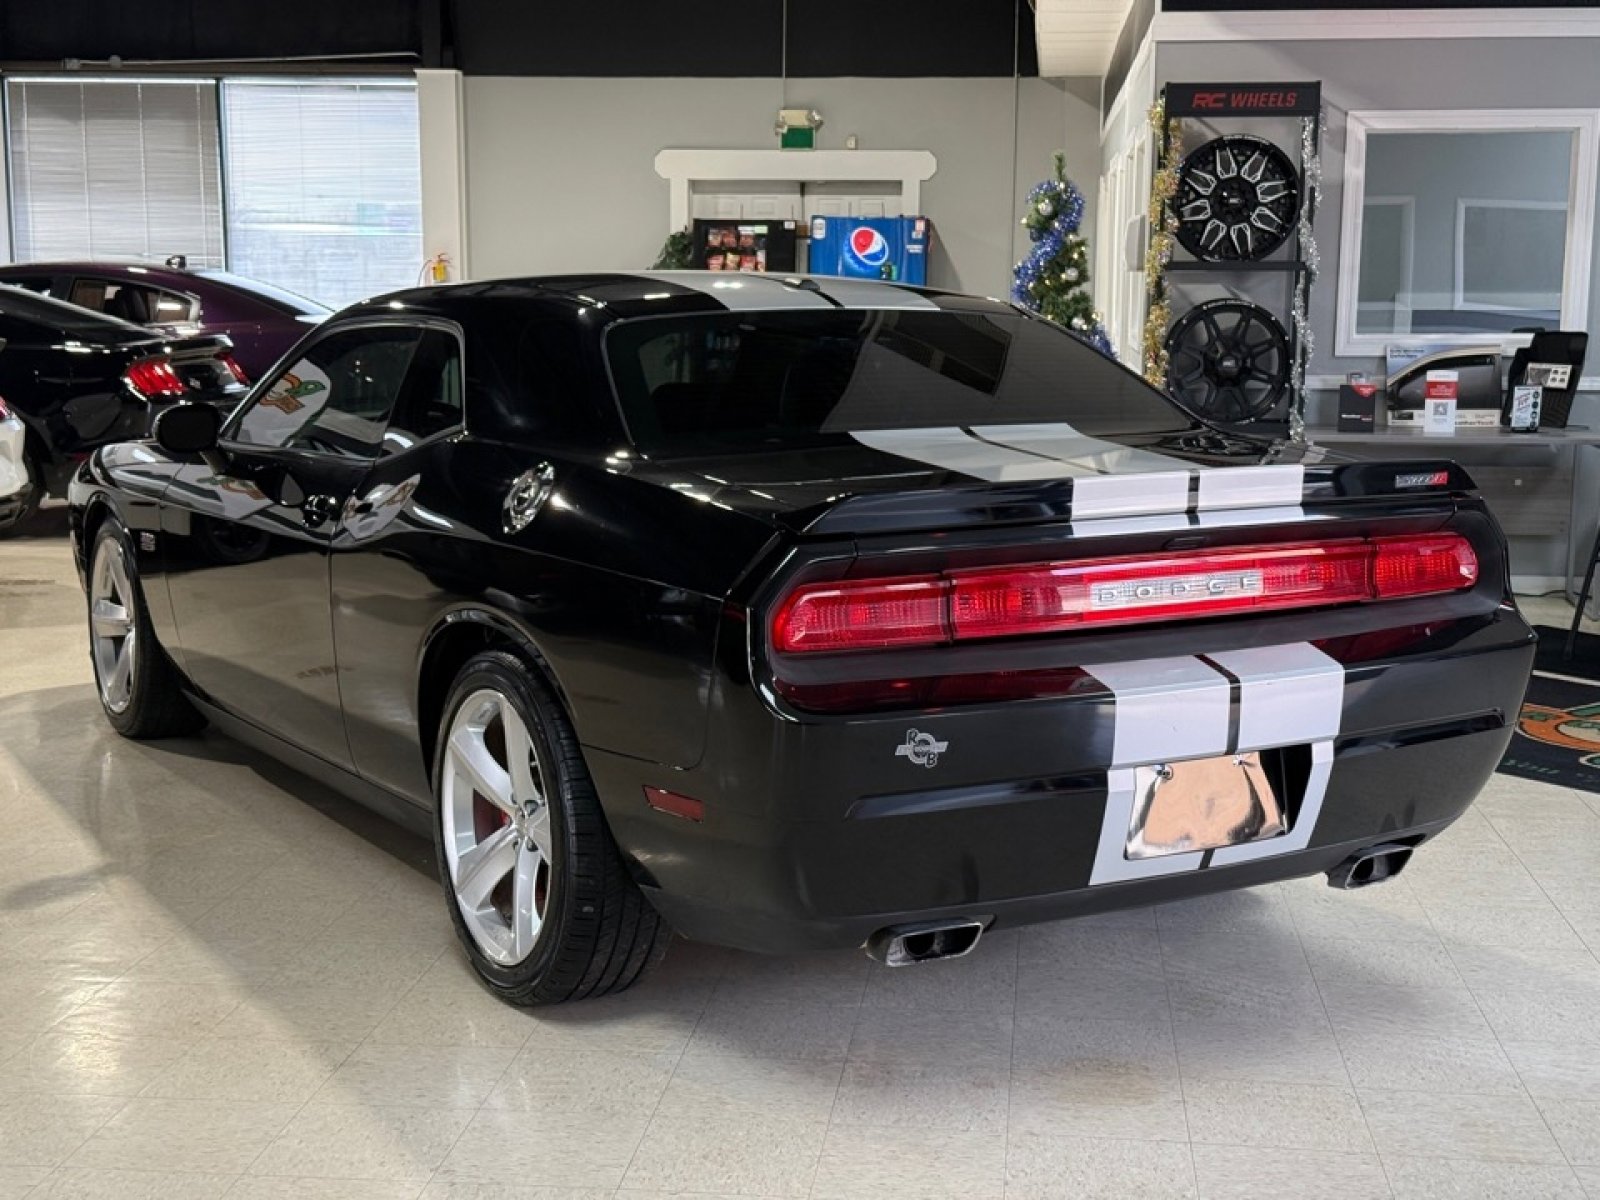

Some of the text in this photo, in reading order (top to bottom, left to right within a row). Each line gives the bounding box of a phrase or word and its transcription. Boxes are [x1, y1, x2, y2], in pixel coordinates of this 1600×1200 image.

[1192, 92, 1298, 109] RC WHEELS
[1099, 576, 1257, 602] DODGE
